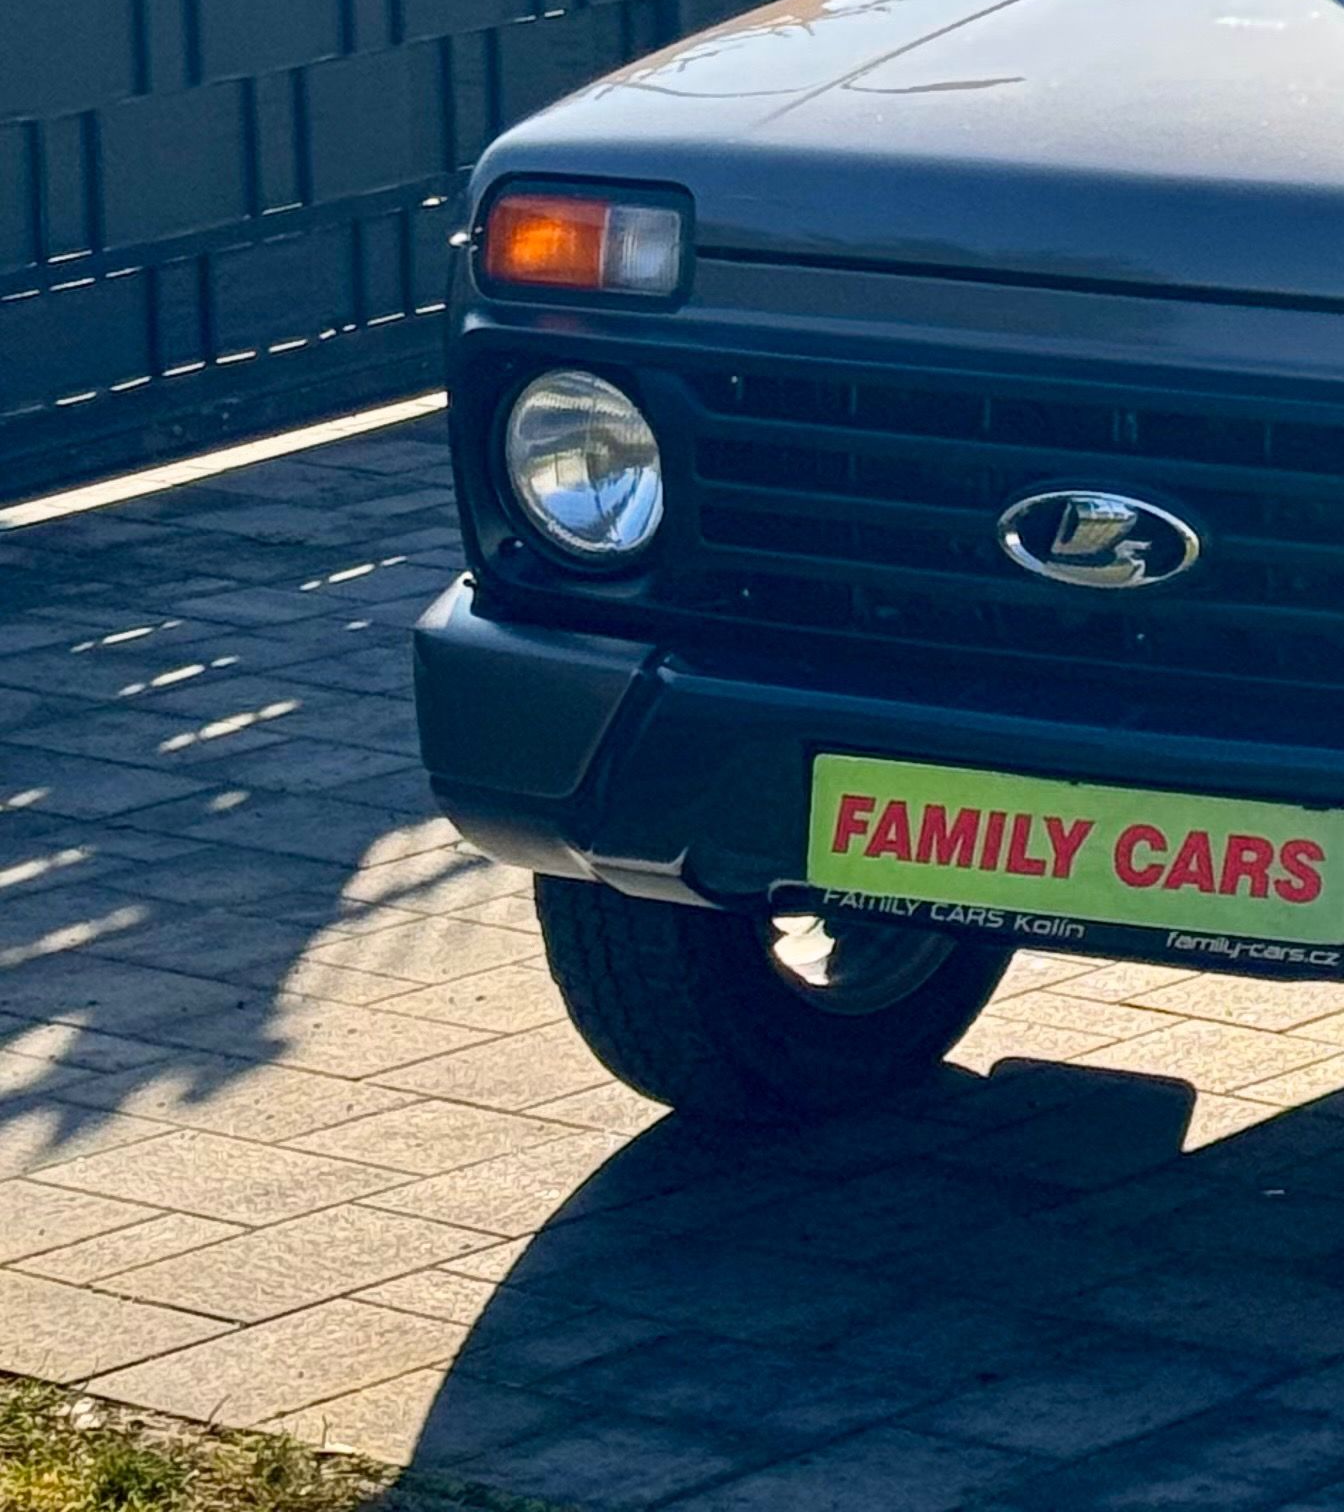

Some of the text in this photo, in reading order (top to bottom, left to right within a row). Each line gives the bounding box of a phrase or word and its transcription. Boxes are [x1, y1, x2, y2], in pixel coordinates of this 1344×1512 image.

[832, 794, 1326, 904] FAMILY CARS
[930, 903, 1005, 928] CARS
[1166, 931, 1341, 966] family-cars.cz
